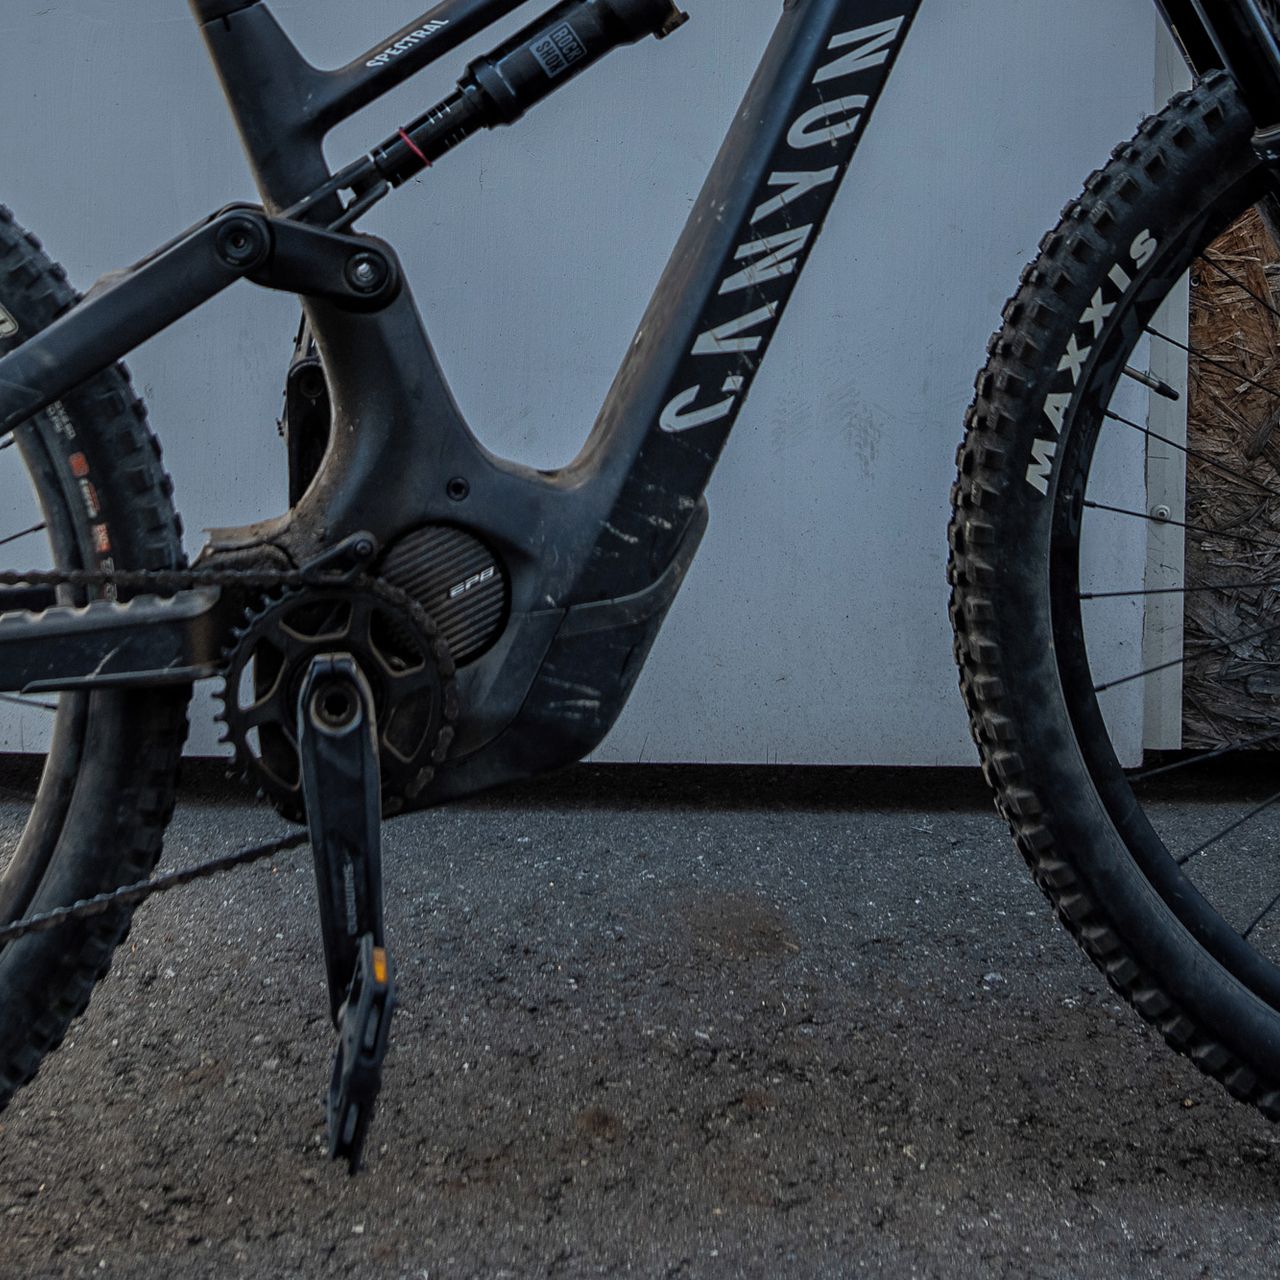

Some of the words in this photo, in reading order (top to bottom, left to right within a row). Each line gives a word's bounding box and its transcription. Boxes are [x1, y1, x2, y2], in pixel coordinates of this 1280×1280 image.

[366, 19, 449, 67] SPECTRAL
[552, 27, 583, 63] ROCK
[659, 15, 905, 433] CANYON
[1025, 228, 1157, 496] MAXXIS
